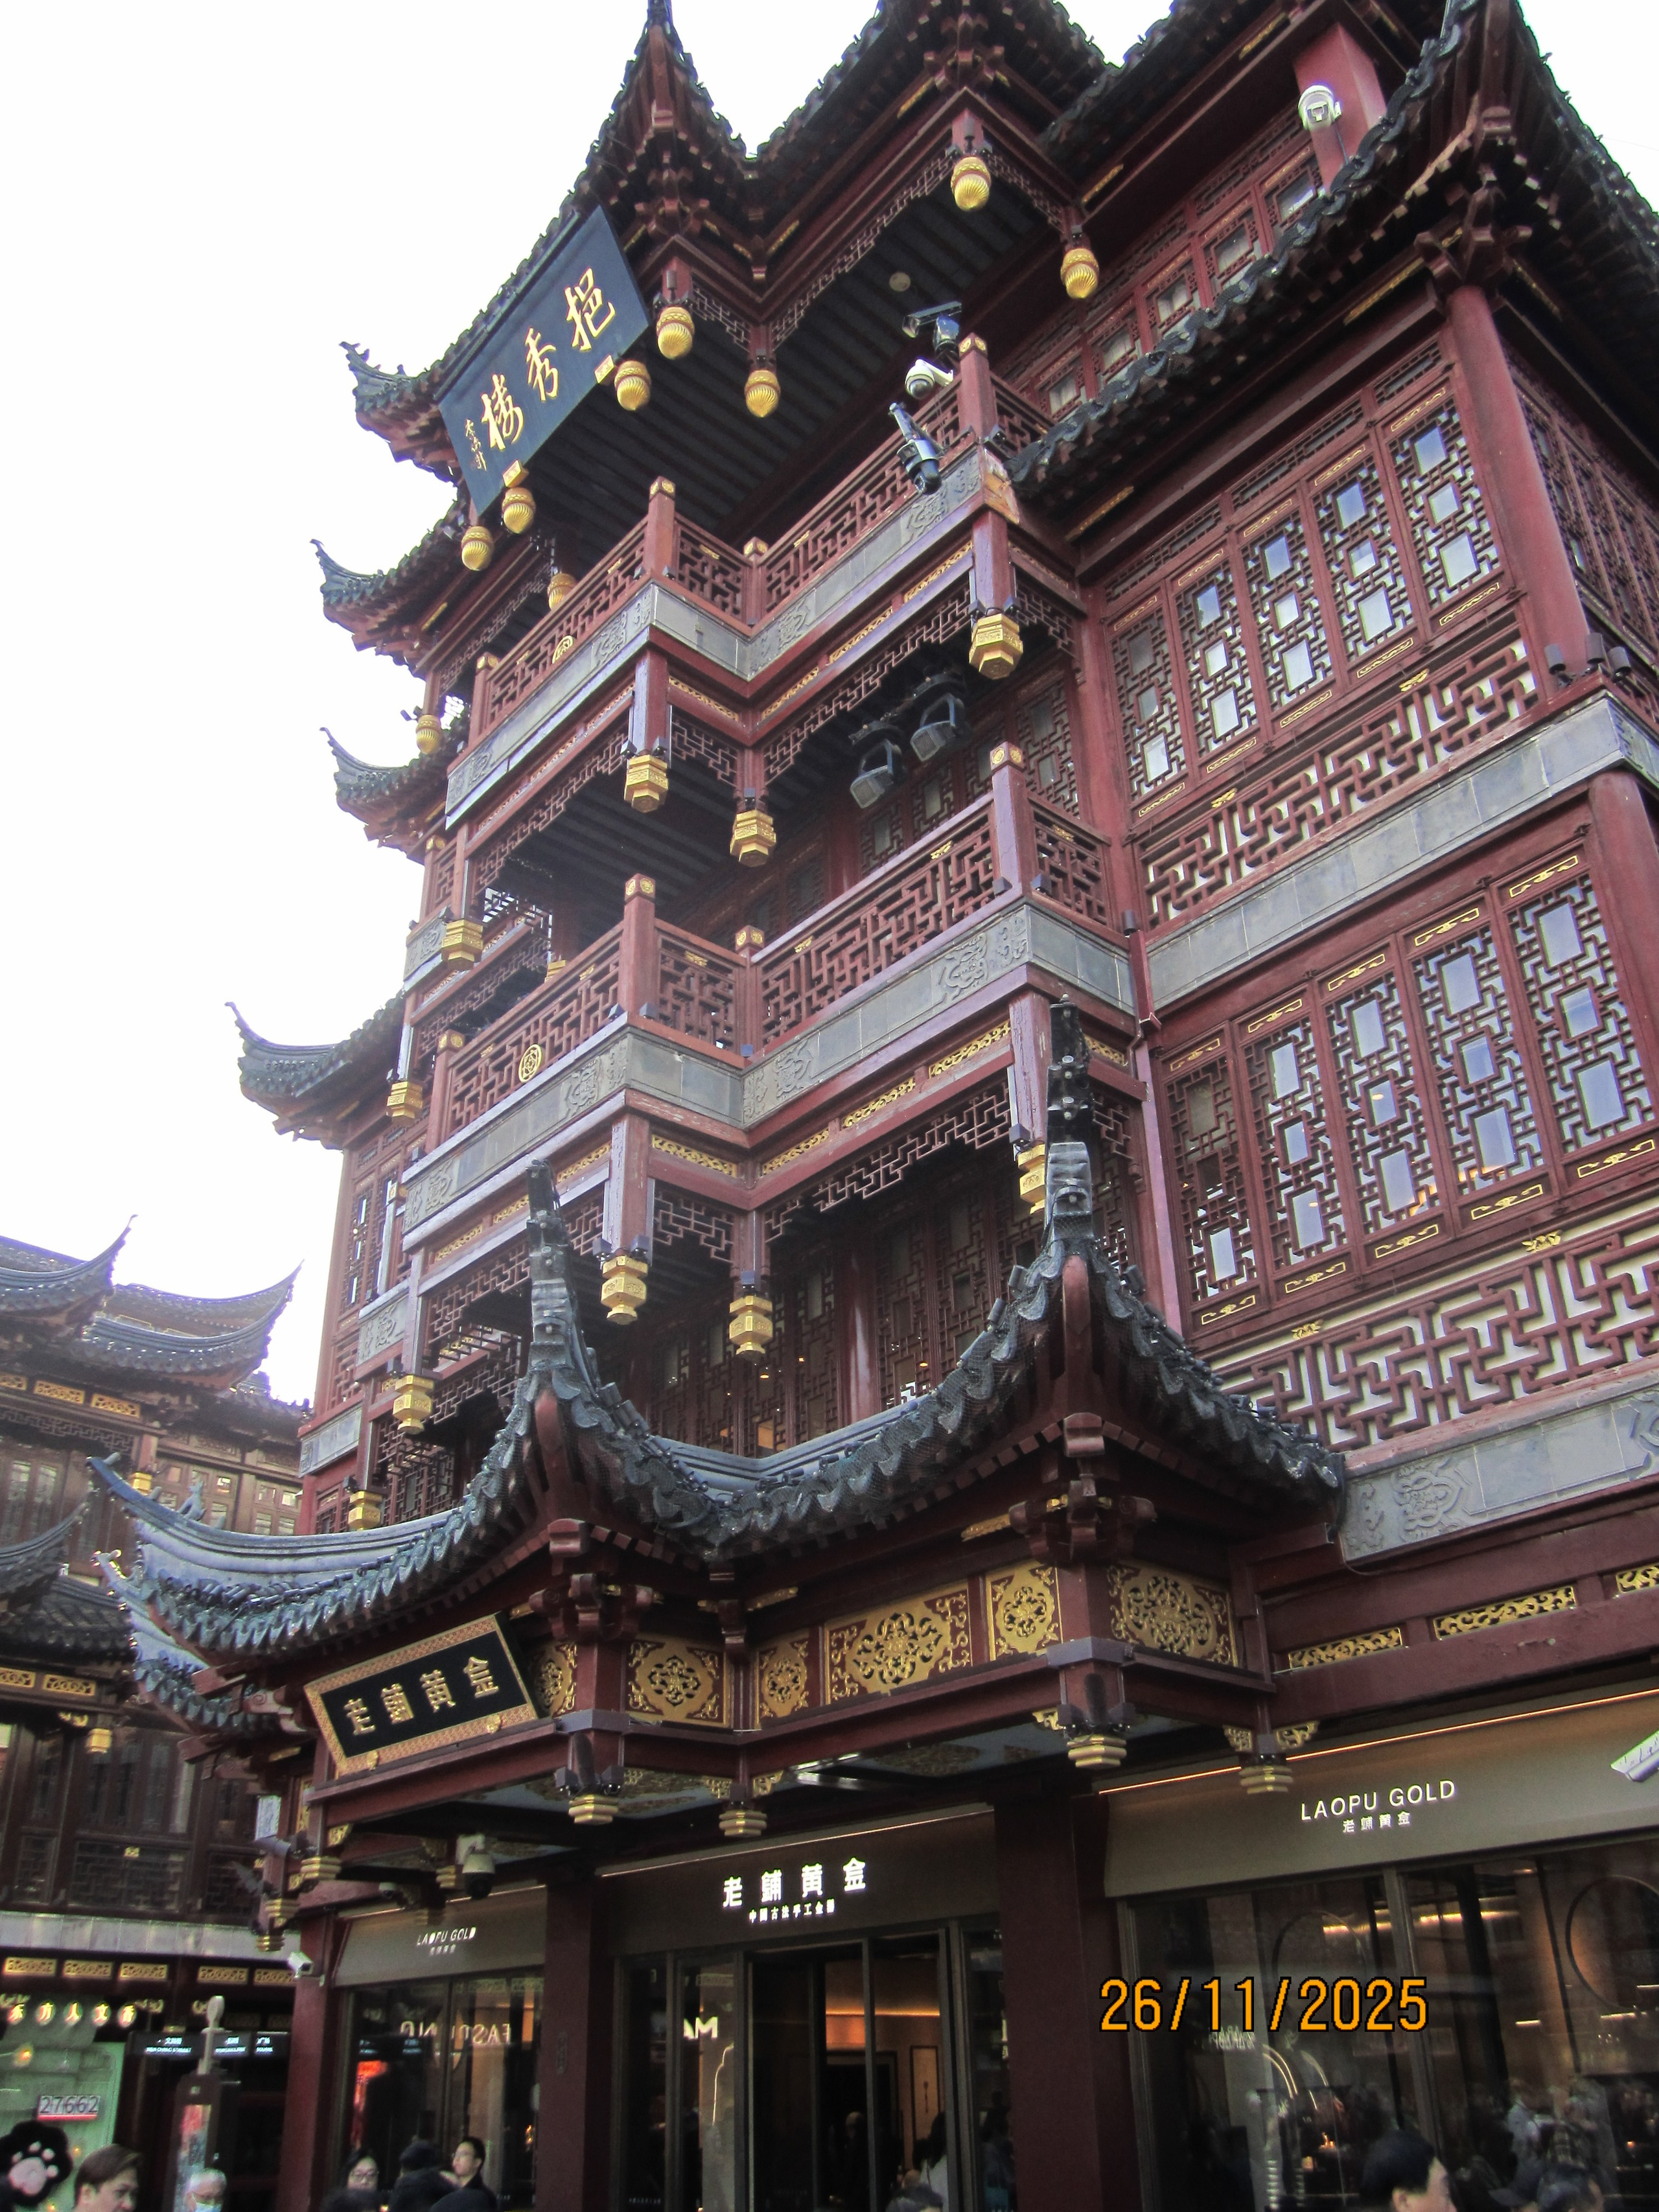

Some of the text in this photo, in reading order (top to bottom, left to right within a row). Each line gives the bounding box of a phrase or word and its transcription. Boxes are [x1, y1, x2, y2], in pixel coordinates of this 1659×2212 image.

[1301, 1780, 1455, 1820] LAOPU GOLD
[450, 1927, 476, 1941] GOLD
[40, 2096, 99, 2113] 27662
